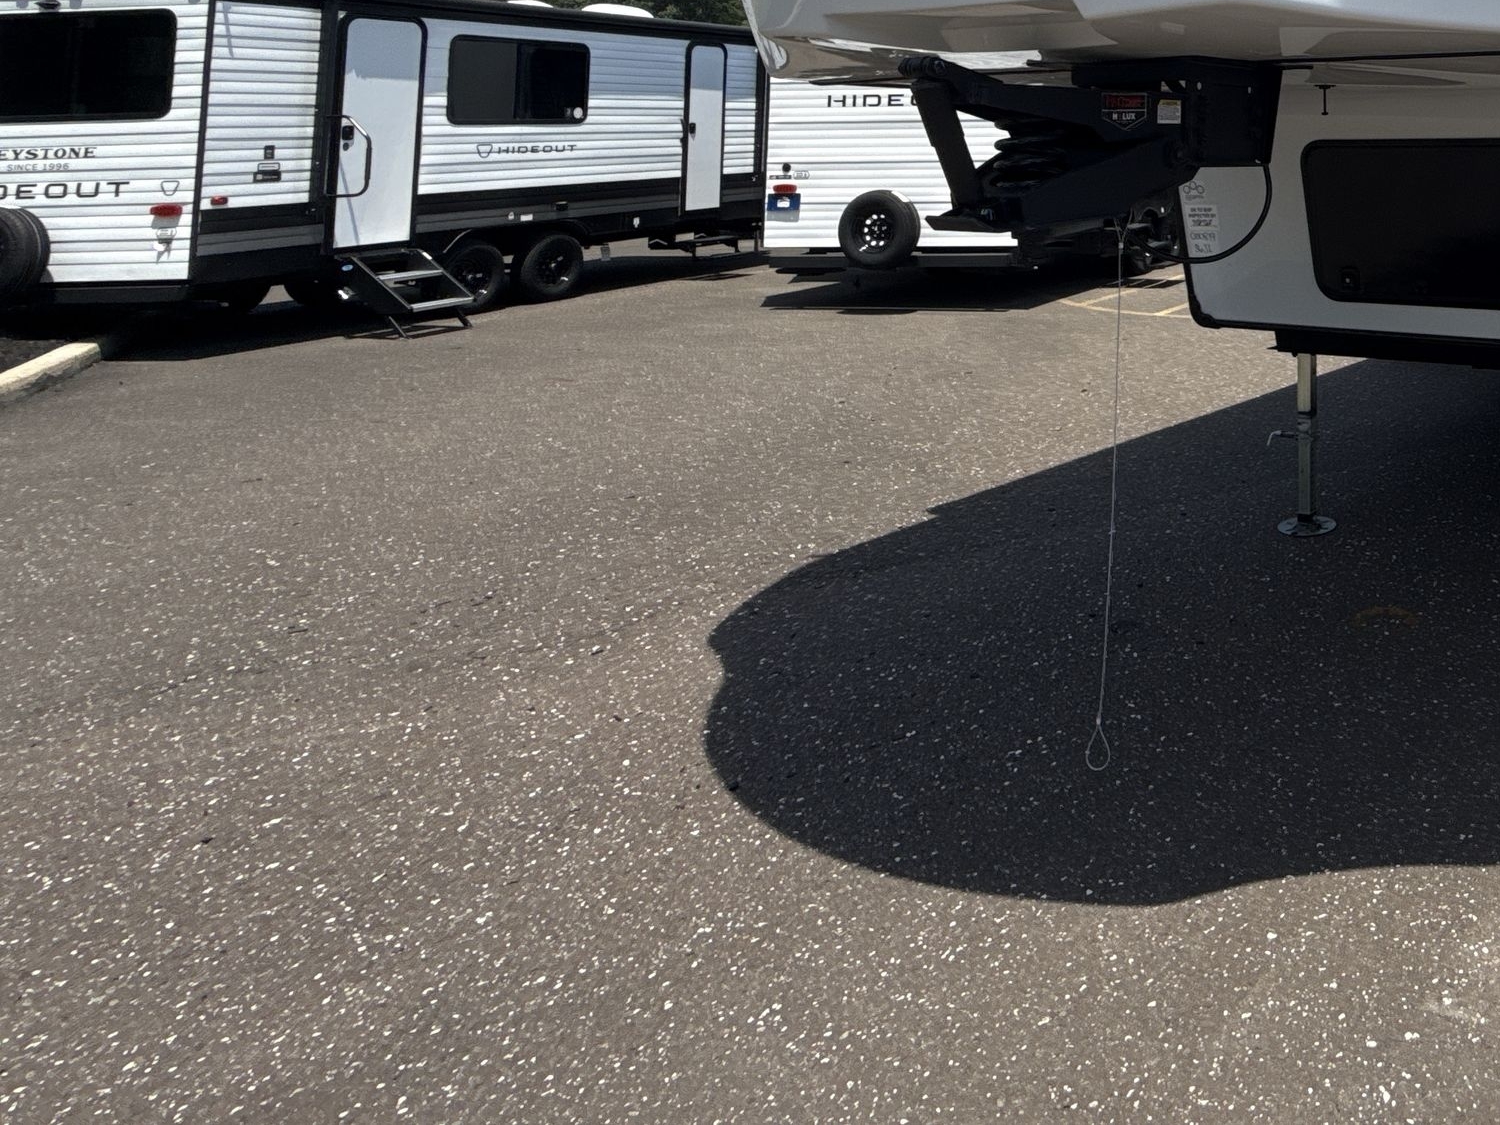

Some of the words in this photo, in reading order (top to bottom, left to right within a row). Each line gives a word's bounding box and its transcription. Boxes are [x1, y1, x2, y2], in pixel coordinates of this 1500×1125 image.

[498, 145, 577, 154] HIDEOUT
[7, 163, 38, 172] SINCE
[42, 162, 70, 171] 1996
